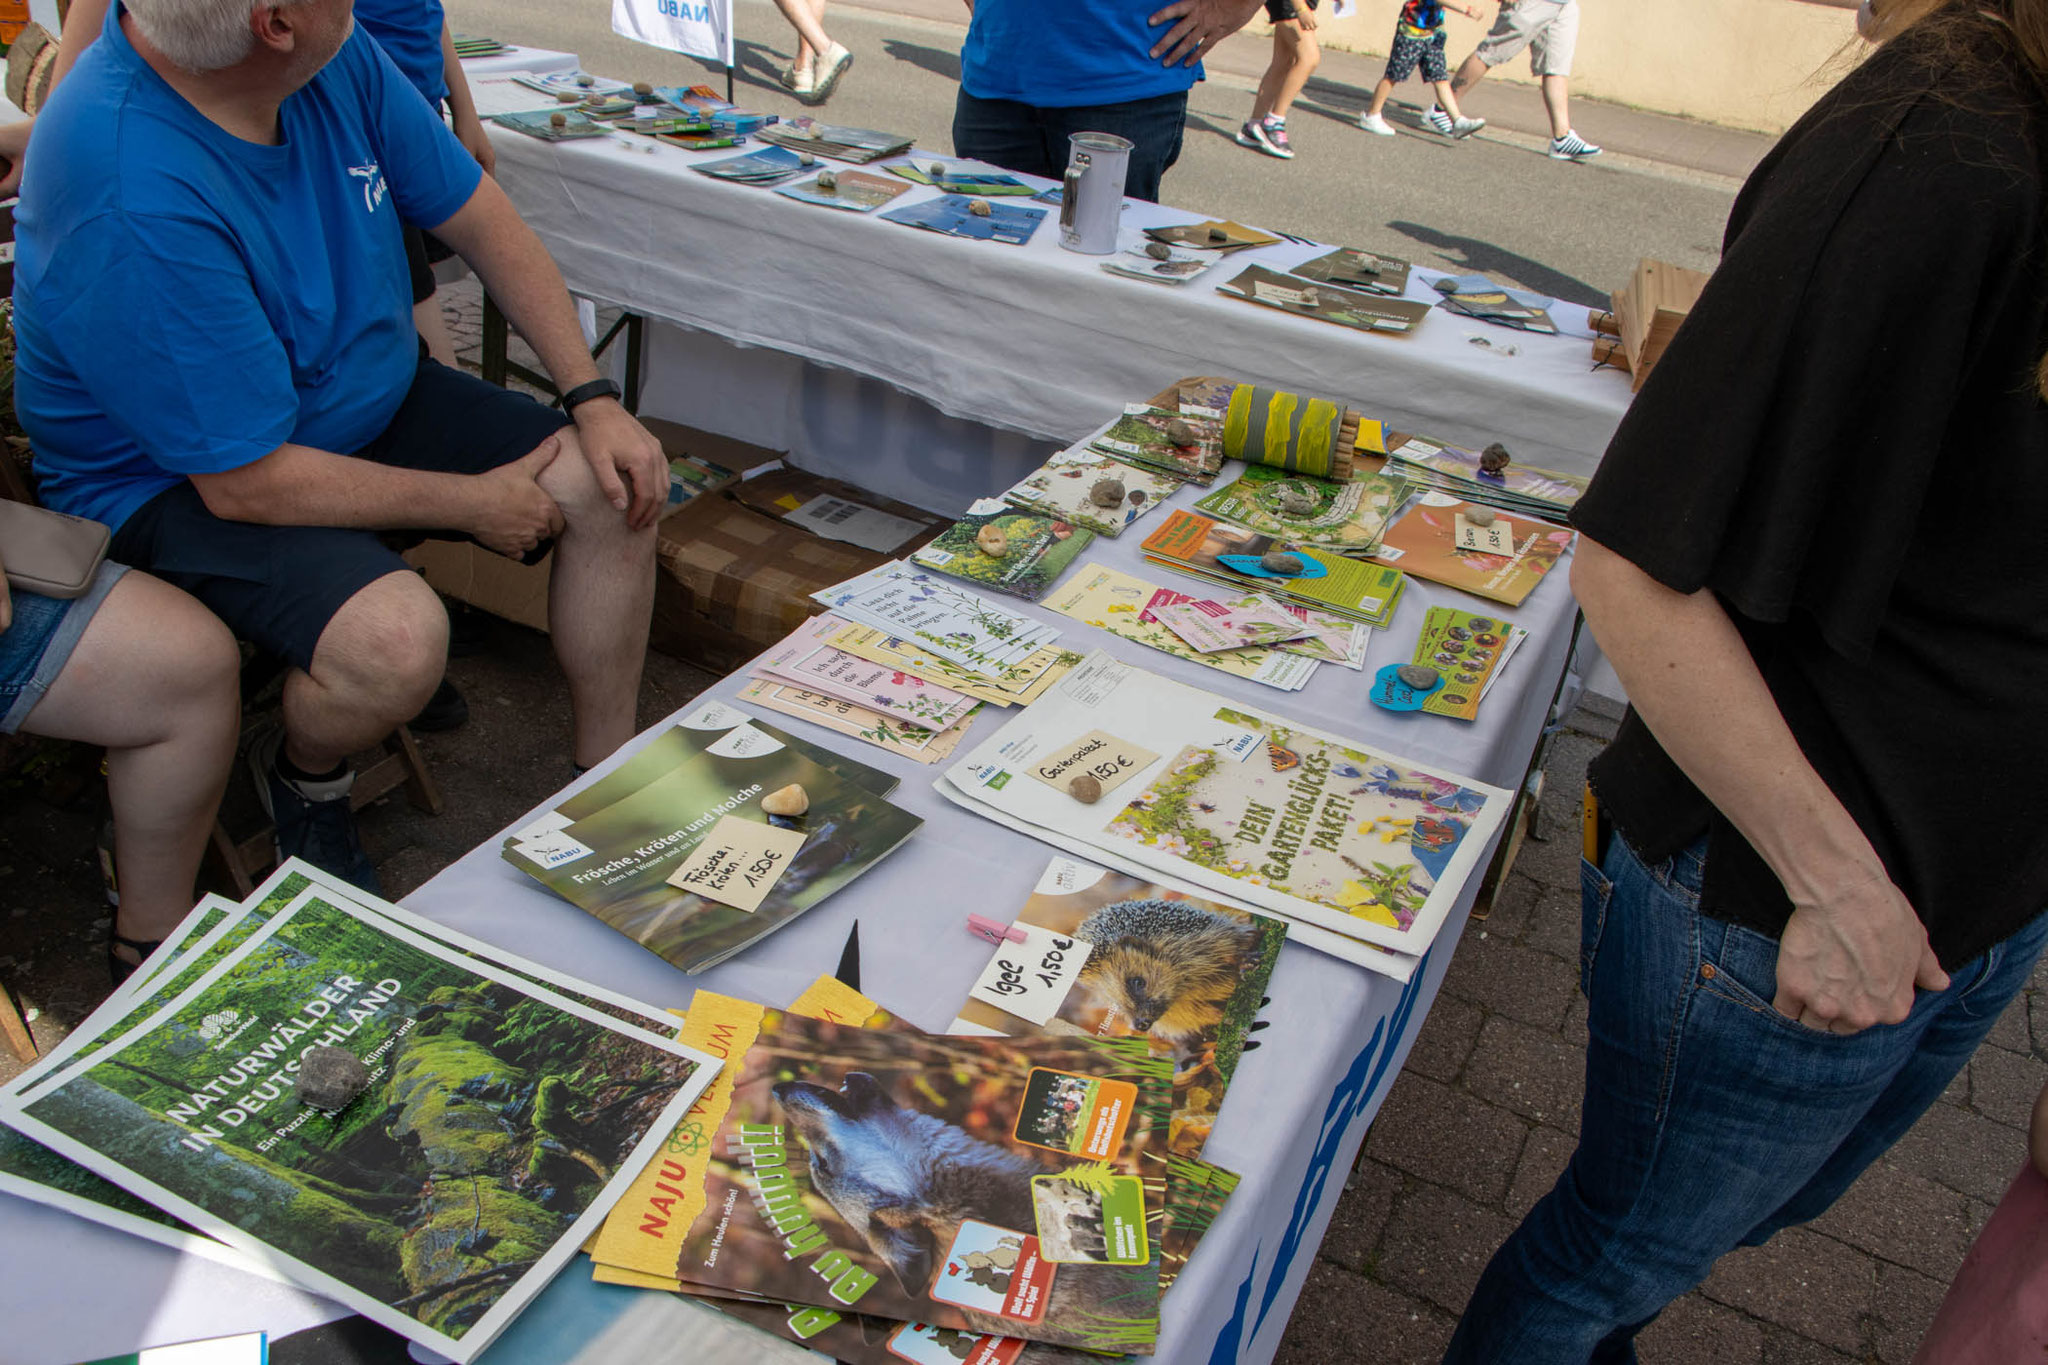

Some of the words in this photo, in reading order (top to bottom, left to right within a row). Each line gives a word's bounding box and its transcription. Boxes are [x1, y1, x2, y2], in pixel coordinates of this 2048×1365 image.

[884, 588, 904, 600] dich
[876, 601, 899, 613] nicht
[887, 608, 902, 619] auf
[902, 603, 917, 613] die
[898, 609, 927, 624] Palme
[813, 662, 829, 673] Ich
[829, 660, 855, 678] durch
[844, 673, 859, 683] die
[856, 670, 887, 689] Blume.
[1232, 734, 1254, 754] NABU
[979, 764, 997, 781] NABU
[1117, 754, 1134, 770] €
[1234, 797, 1276, 845] DEIN
[1259, 749, 1331, 881] GARTENGLÜCKS-
[1310, 792, 1356, 853] PAKET!
[571, 853, 642, 885] Frösche,
[634, 829, 688, 860] Kröten
[685, 811, 716, 833] und
[711, 783, 763, 817] Molche
[550, 847, 581, 863] NABU
[601, 873, 627, 887] Leben
[626, 868, 638, 879] im
[637, 855, 665, 872] Wasser
[666, 847, 681, 858] und
[681, 841, 692, 851] an
[1036, 938, 1074, 989] 1,50€
[983, 959, 1028, 996] Igel
[165, 974, 363, 1124] NATURWÄLDER
[256, 1137, 278, 1153] Ein
[361, 1035, 397, 1068] Klima-
[394, 1016, 418, 1039] und
[181, 1123, 225, 1153] IN
[639, 1159, 688, 1239] NAJU
[723, 1188, 739, 1216] schön!
[711, 1217, 729, 1247] Heulen
[704, 1248, 719, 1268] Zum
[1010, 1296, 1024, 1315] Wolf
[1018, 1279, 1030, 1298] sucht
[1026, 1286, 1040, 1305] Spiel
